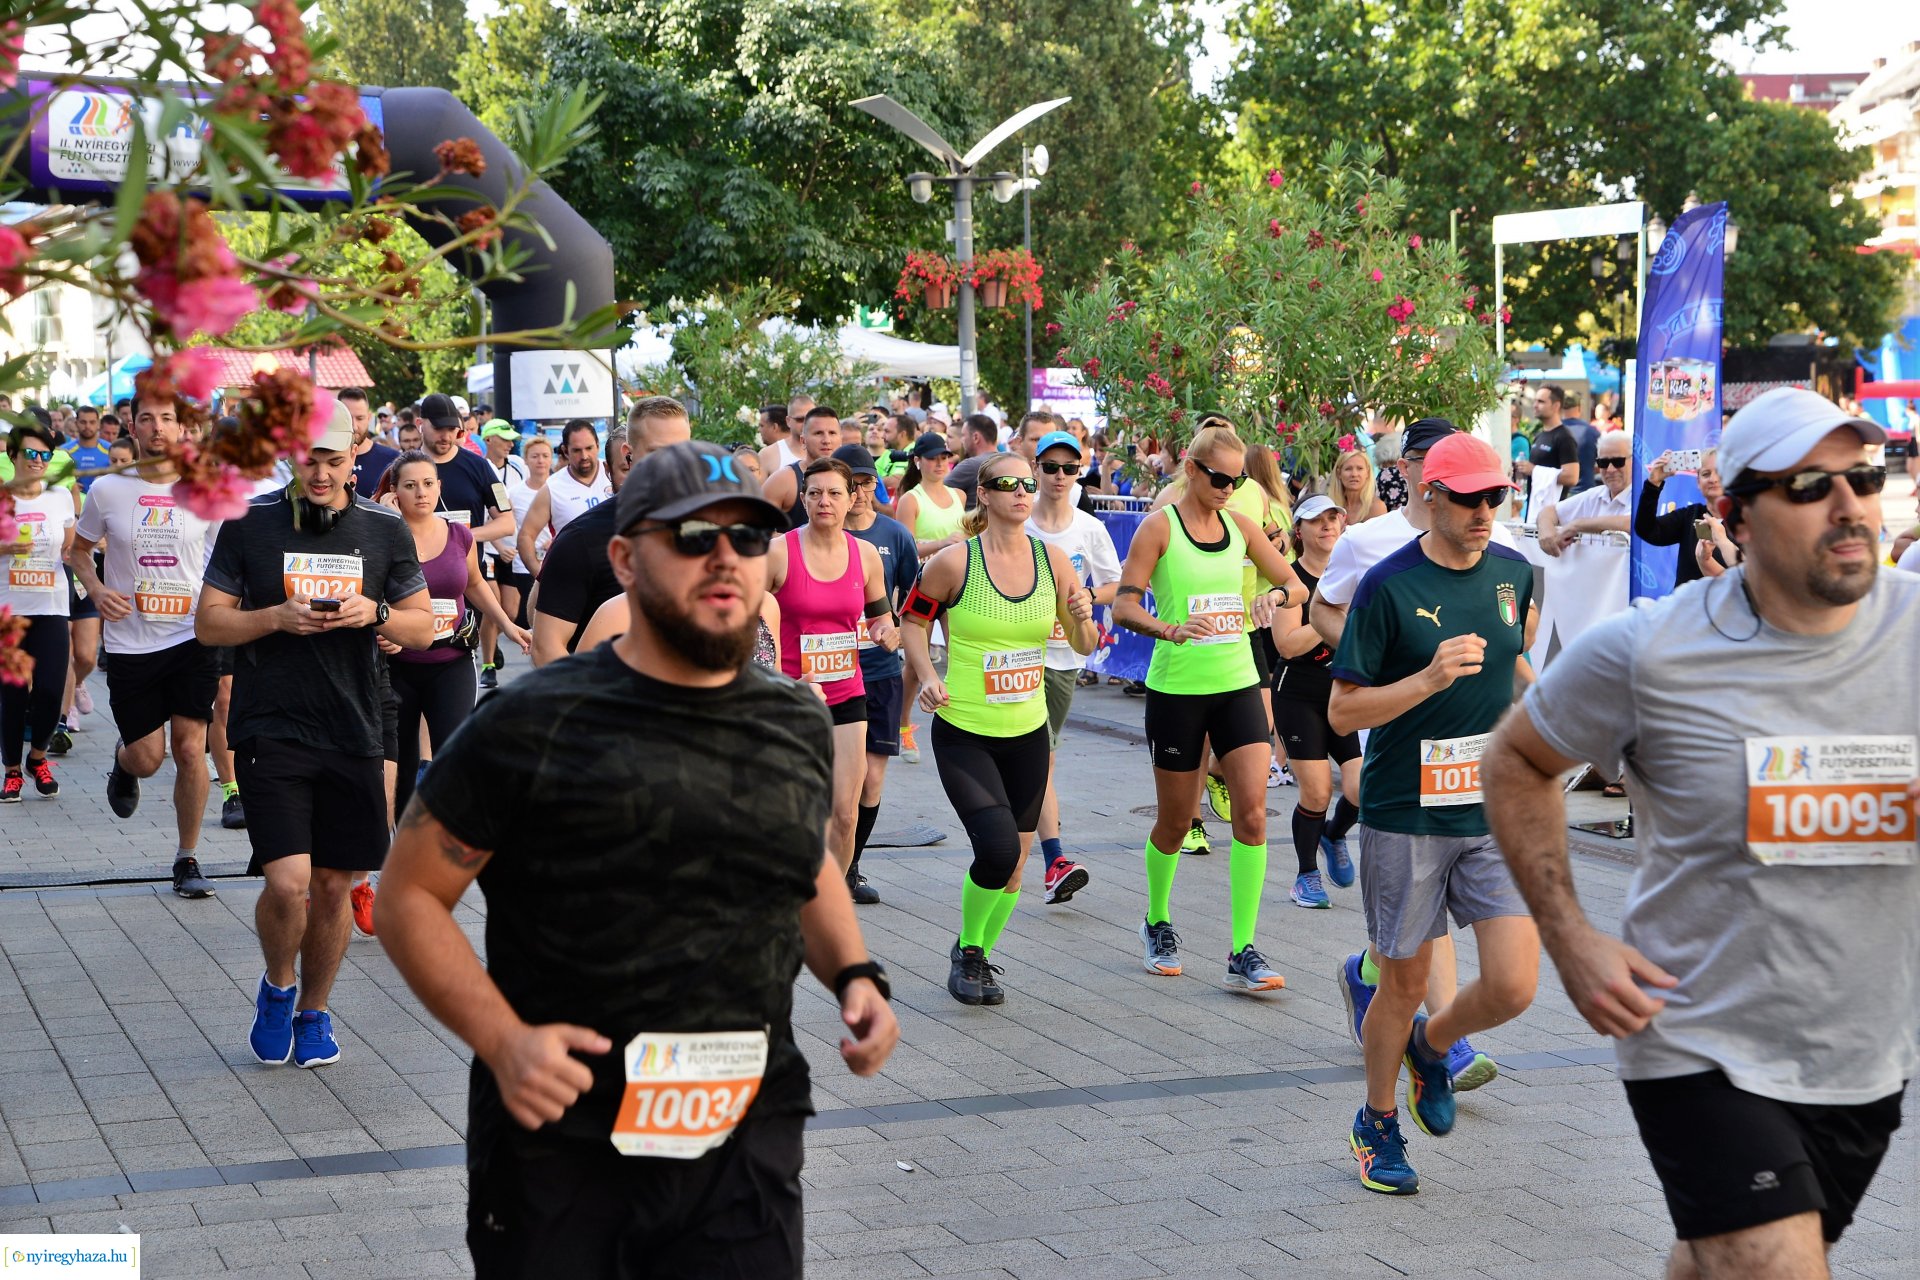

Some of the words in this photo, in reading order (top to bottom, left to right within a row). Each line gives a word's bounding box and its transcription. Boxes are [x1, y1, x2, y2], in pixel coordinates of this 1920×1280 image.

[75, 138, 155, 153] NYÍREGYZI
[60, 149, 154, 165] FUTÓFESZTL
[13, 572, 51, 585] 10041
[291, 577, 356, 598] 10024
[141, 596, 183, 613] 10111
[1216, 614, 1244, 632] 083
[808, 652, 853, 672] 10134
[991, 670, 1040, 691] 10079
[1431, 765, 1482, 791] 1013
[1765, 791, 1907, 837] 10095
[635, 1085, 752, 1130] 10034
